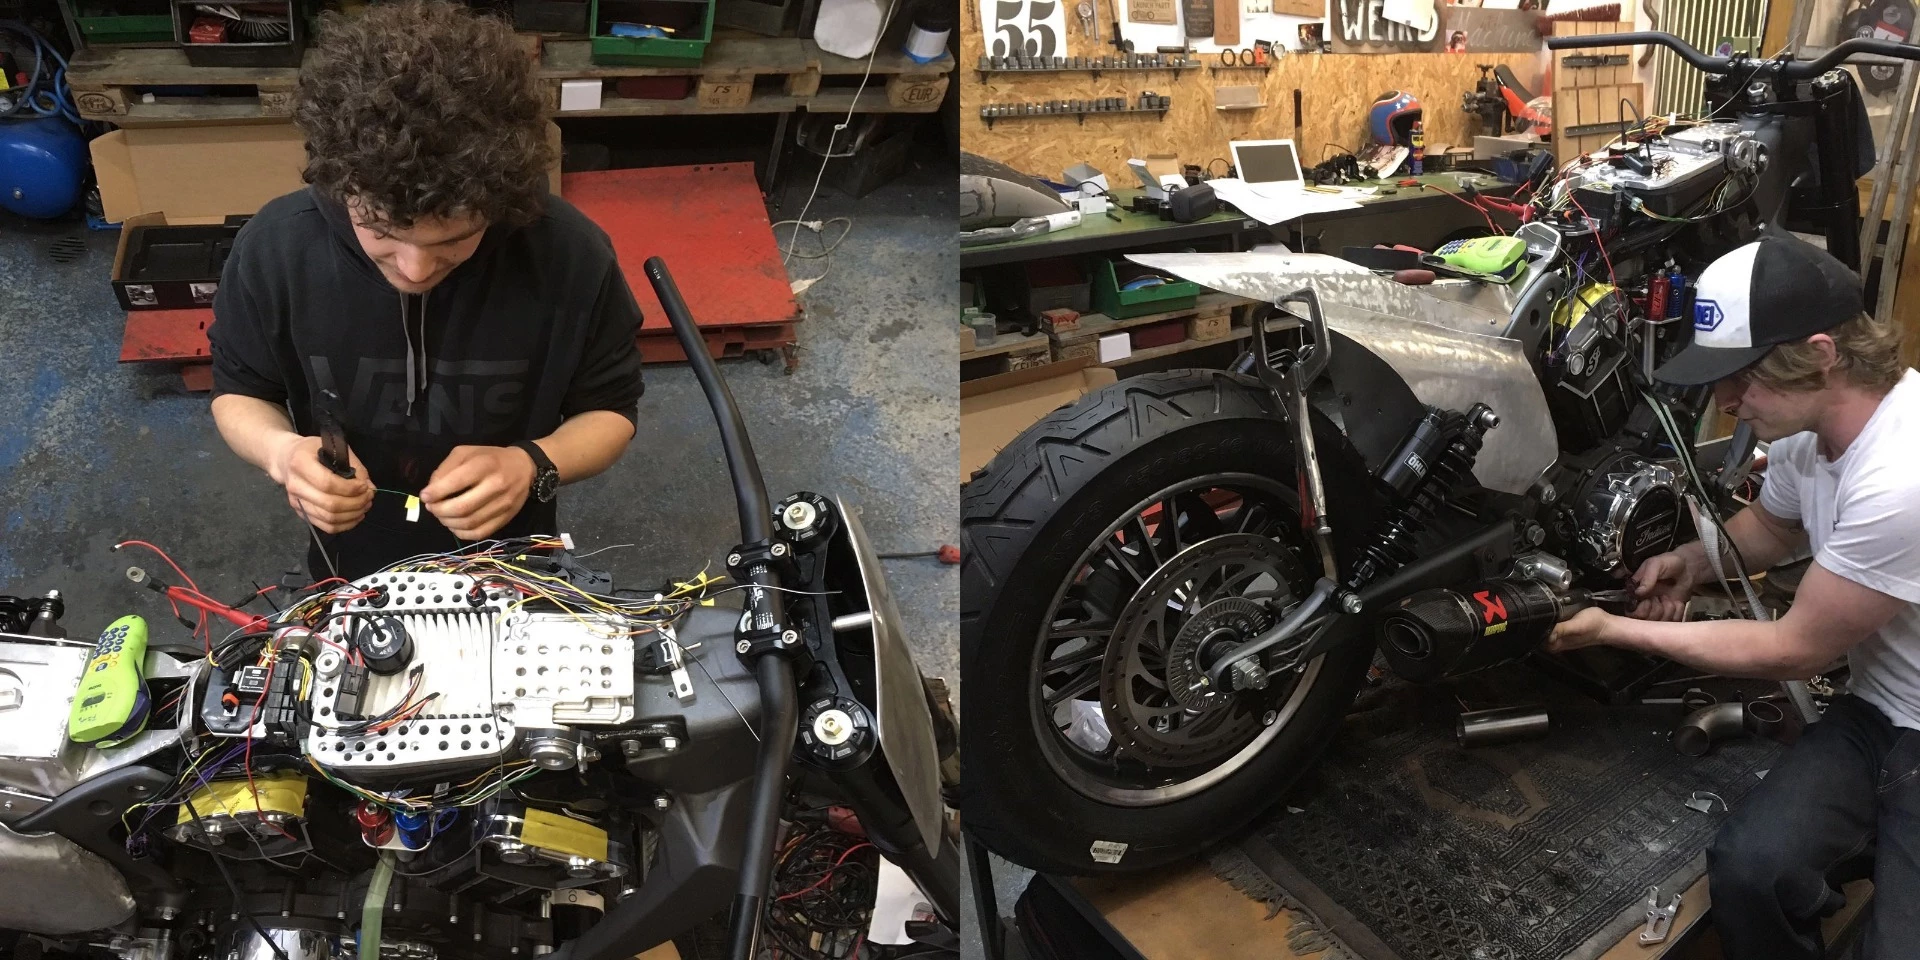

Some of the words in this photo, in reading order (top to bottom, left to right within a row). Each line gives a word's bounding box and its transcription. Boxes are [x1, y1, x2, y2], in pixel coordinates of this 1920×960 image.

[992, 0, 1057, 58] 55
[908, 87, 931, 101] EUR
[310, 356, 529, 436] VANS
